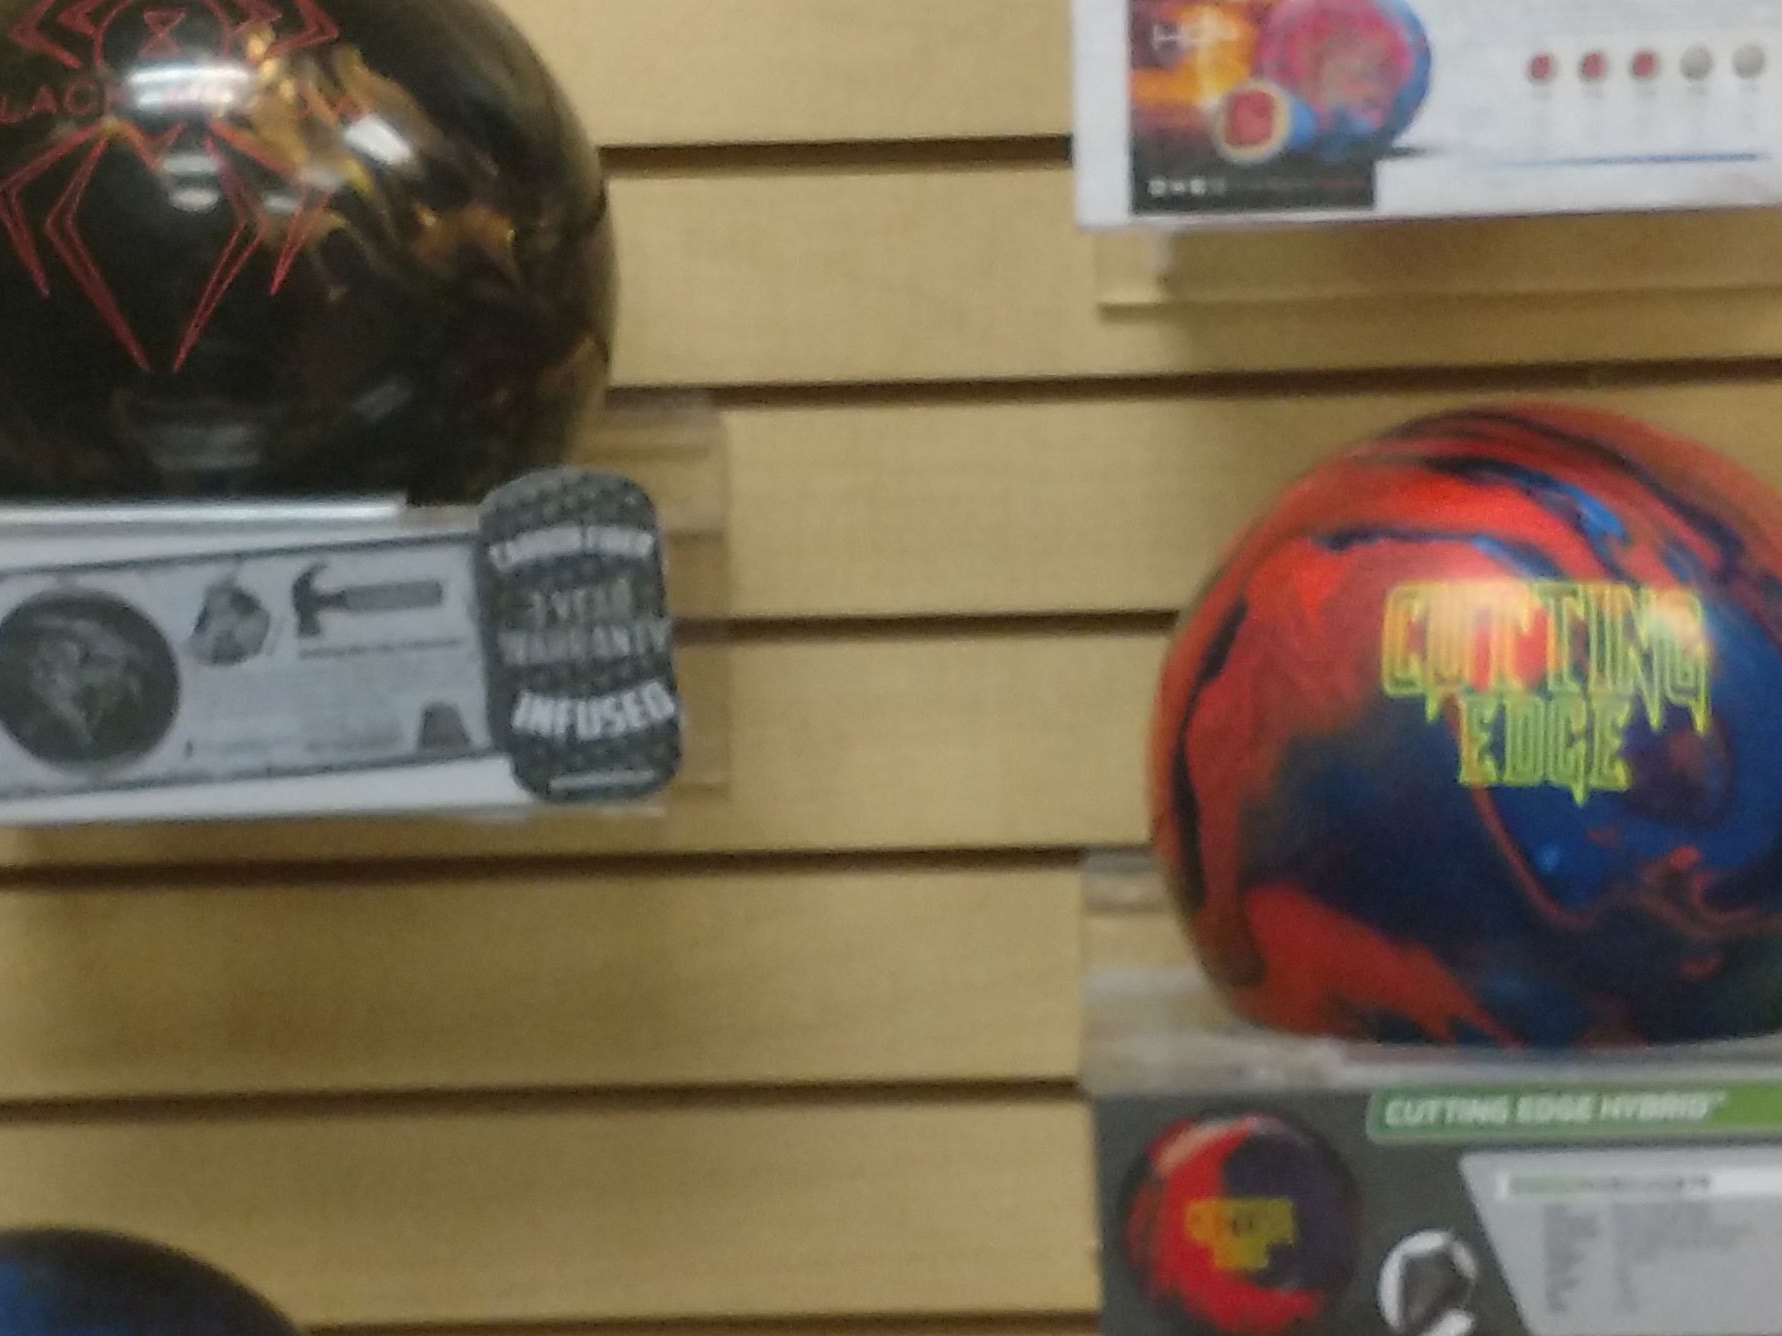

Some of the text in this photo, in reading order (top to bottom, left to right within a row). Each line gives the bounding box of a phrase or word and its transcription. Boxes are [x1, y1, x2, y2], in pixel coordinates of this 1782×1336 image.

[1382, 578, 1709, 736] CUTTING
[511, 681, 675, 741] INFUSED
[1458, 690, 1632, 806] EDGE
[1385, 1096, 1508, 1127] CUTTING
[1518, 1094, 1592, 1124] EDGE
[1601, 1092, 1709, 1120] HYBRID
